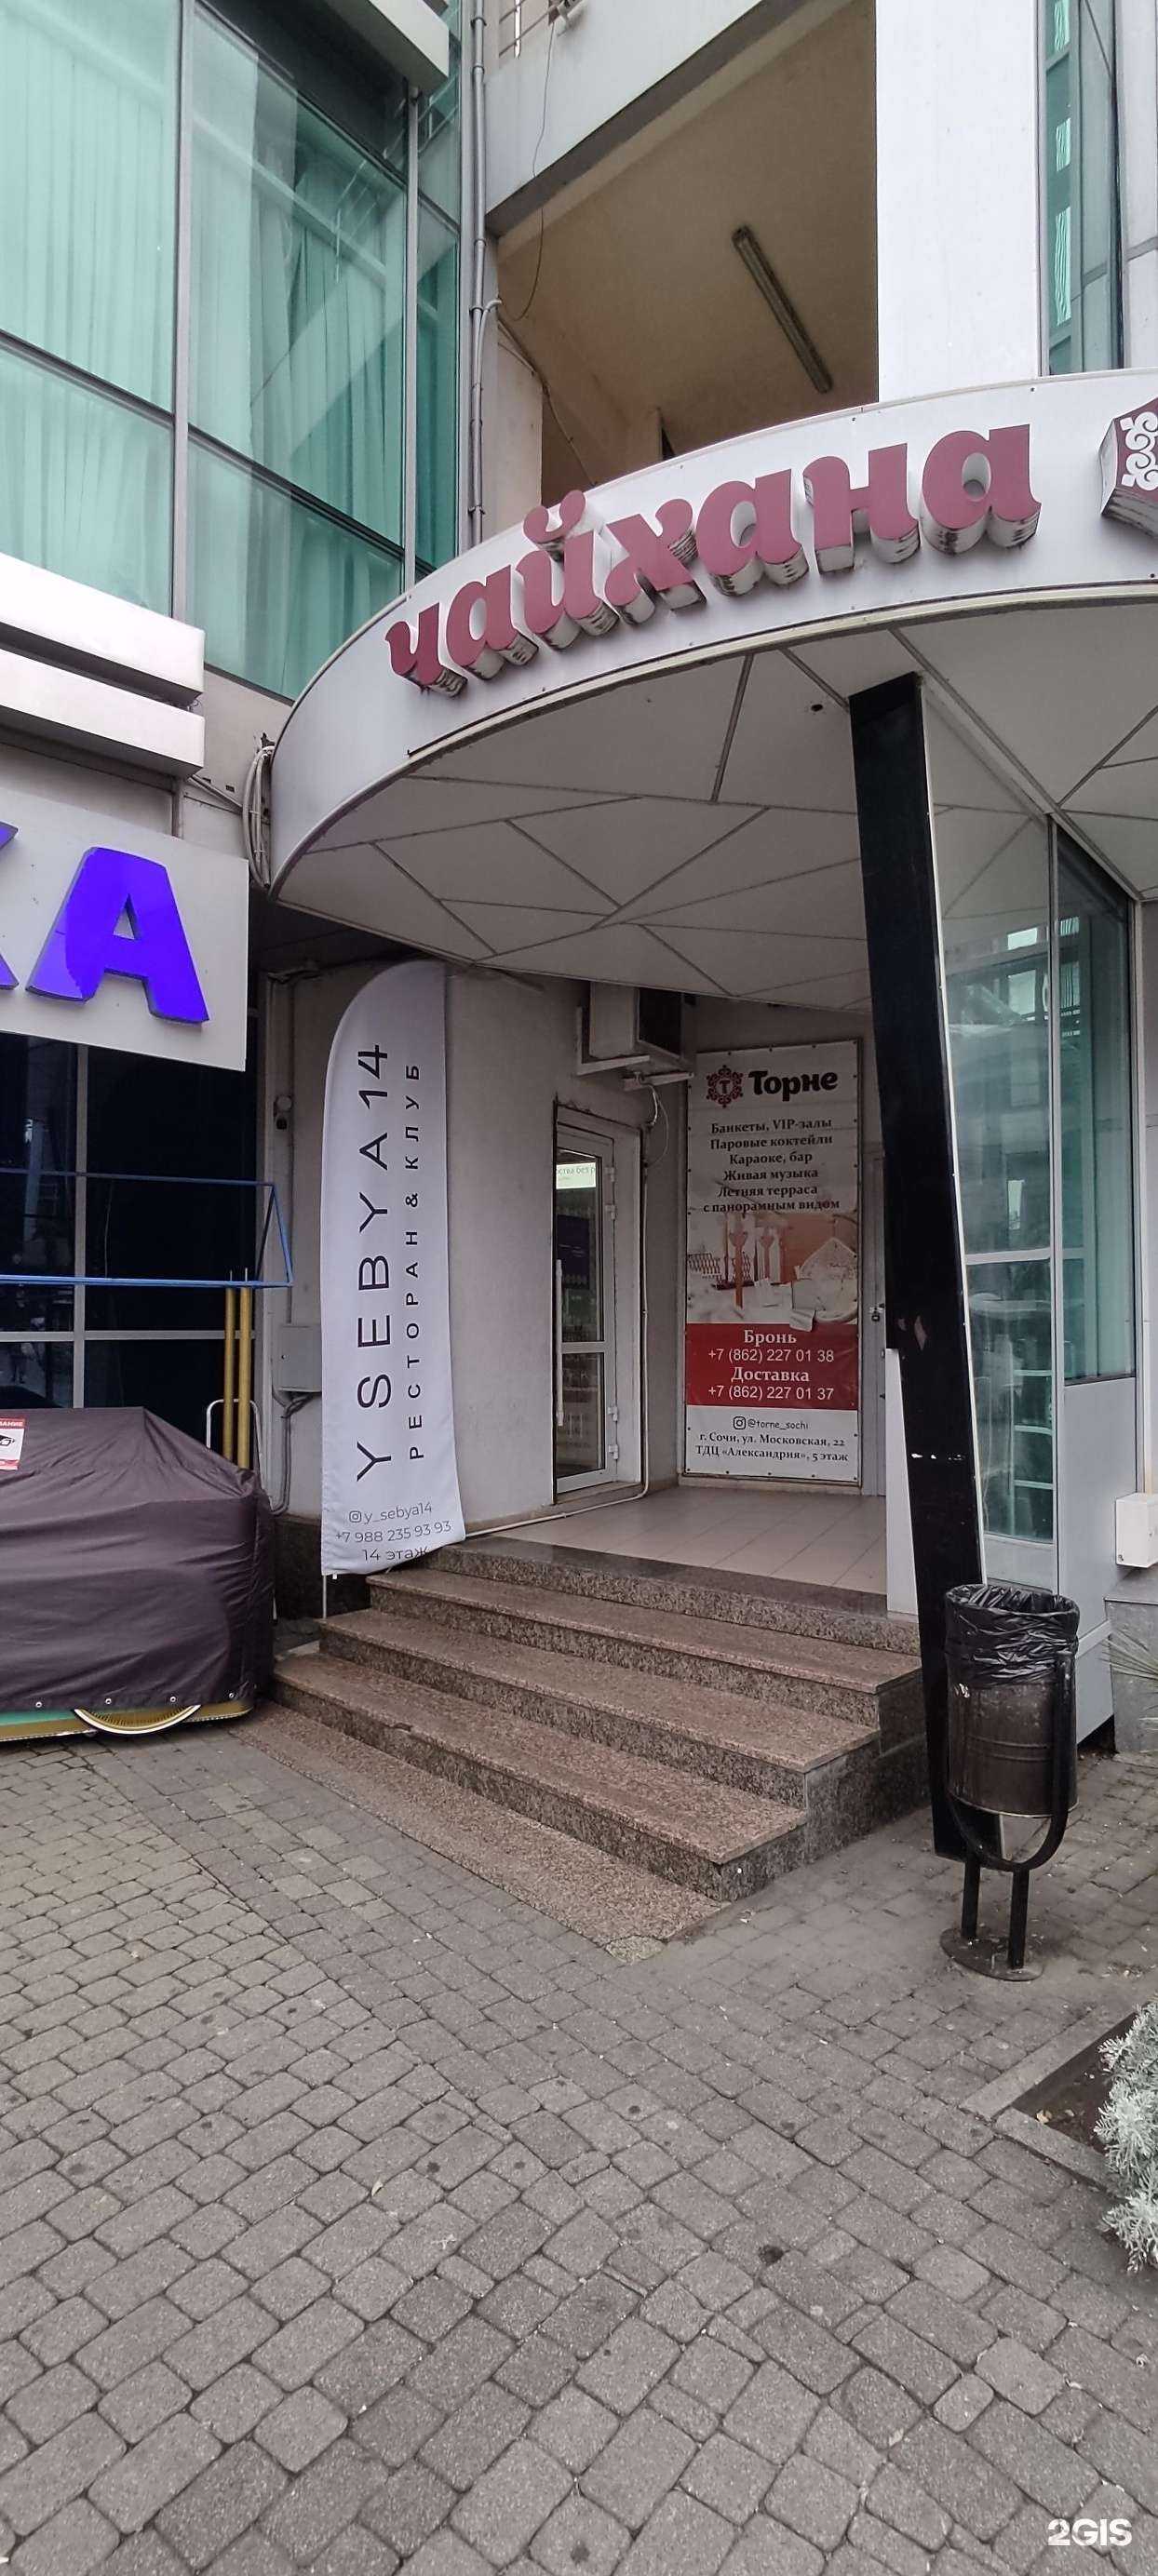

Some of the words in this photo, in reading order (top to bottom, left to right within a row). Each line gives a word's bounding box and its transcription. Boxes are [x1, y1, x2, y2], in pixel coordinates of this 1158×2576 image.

[384, 423, 1043, 693] чайхана
[0, 821, 209, 1024] А
[748, 1070, 838, 1102] Торне
[405, 1065, 420, 1170] КЛУБ
[711, 1122, 769, 1134] Банкеты,
[773, 1118, 832, 1130] VIP-залы
[710, 1138, 767, 1151] Паровые
[771, 1134, 832, 1147] коктейли
[730, 1154, 787, 1167] Караоке,
[789, 1151, 813, 1164] бар
[723, 1171, 766, 1181] Живая
[770, 1170, 818, 1182] музыка
[405, 1192, 418, 1208] &
[718, 1187, 763, 1198] Летняя
[767, 1187, 818, 1199] терраса
[703, 1204, 711, 1213] с
[712, 1201, 795, 1214] панорамным
[799, 1200, 840, 1211] видом
[405, 1231, 424, 1460] РЕСТОРАН
[744, 1329, 797, 1347] Бронь
[708, 1349, 723, 1362] +7
[729, 1349, 762, 1363] (862)
[767, 1349, 792, 1362] 227
[796, 1350, 811, 1362] 01
[817, 1350, 834, 1362] 38
[731, 1366, 809, 1383] Доставка
[708, 1386, 723, 1398] +7
[729, 1386, 762, 1401] (862)
[767, 1387, 791, 1399] 227
[796, 1388, 811, 1400] 01
[817, 1388, 834, 1401] 37
[747, 1417, 809, 1430] @torne_sochi
[709, 1432, 740, 1443] Сочи,
[742, 1435, 756, 1444] ул.
[760, 1435, 830, 1447] Московская,
[695, 1446, 720, 1457] ТДЦ
[722, 1447, 809, 1462] «Александрия»,
[812, 1452, 818, 1461] 5
[820, 1452, 849, 1462] этаж
[364, 1501, 433, 1524] y_sebya14
[336, 1531, 350, 1543] +7
[355, 1531, 383, 1543] 988
[388, 1528, 411, 1541] 235
[415, 1523, 431, 1536] 93
[434, 1521, 451, 1534] 93
[362, 1549, 381, 1561] 14
[386, 1546, 429, 1561] этаж
